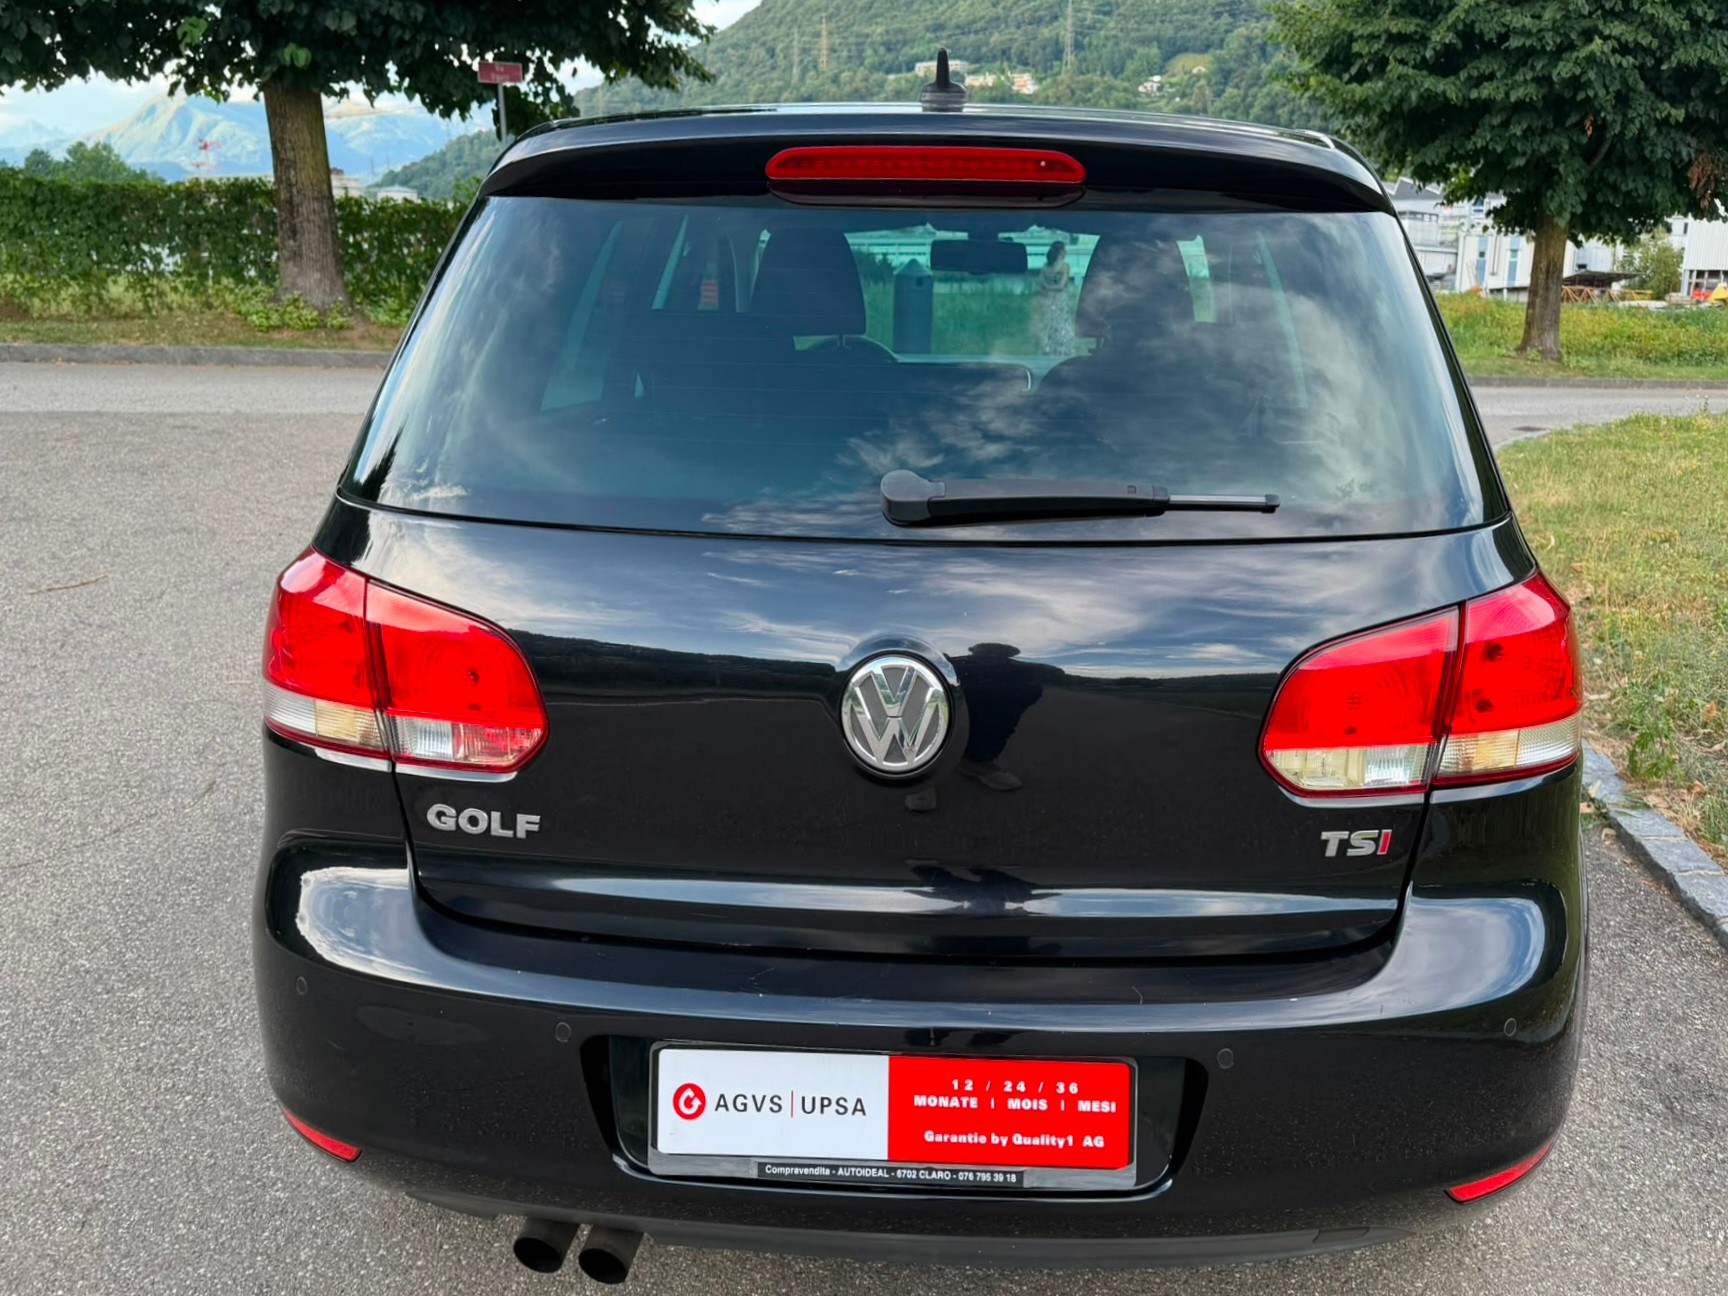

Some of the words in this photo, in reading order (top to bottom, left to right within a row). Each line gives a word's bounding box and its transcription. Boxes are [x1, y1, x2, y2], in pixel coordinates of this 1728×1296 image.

[426, 803, 541, 839] GOLF
[1320, 829, 1393, 858] TSI
[951, 1079, 974, 1091] 12
[1003, 1080, 1026, 1093] 24
[1055, 1082, 1079, 1095] 36
[714, 1093, 783, 1113] AGVS
[801, 1096, 867, 1116] UPSA
[913, 1095, 979, 1109] MONATE
[1007, 1098, 1049, 1111] MOIS
[1077, 1100, 1117, 1114] MESI
[923, 1130, 987, 1145] Garantie
[990, 1132, 1009, 1148] by
[1011, 1133, 1074, 1149] Quality1
[1082, 1135, 1105, 1149] AG
[764, 1164, 831, 1177] Compravendita
[837, 1167, 890, 1178] AUTOIDEAL
[896, 1169, 917, 1179] 6702
[918, 1170, 951, 1180] CLARO
[957, 1172, 974, 1181] 076
[976, 1172, 992, 1182] 795
[1006, 1173, 1017, 1183] 18
